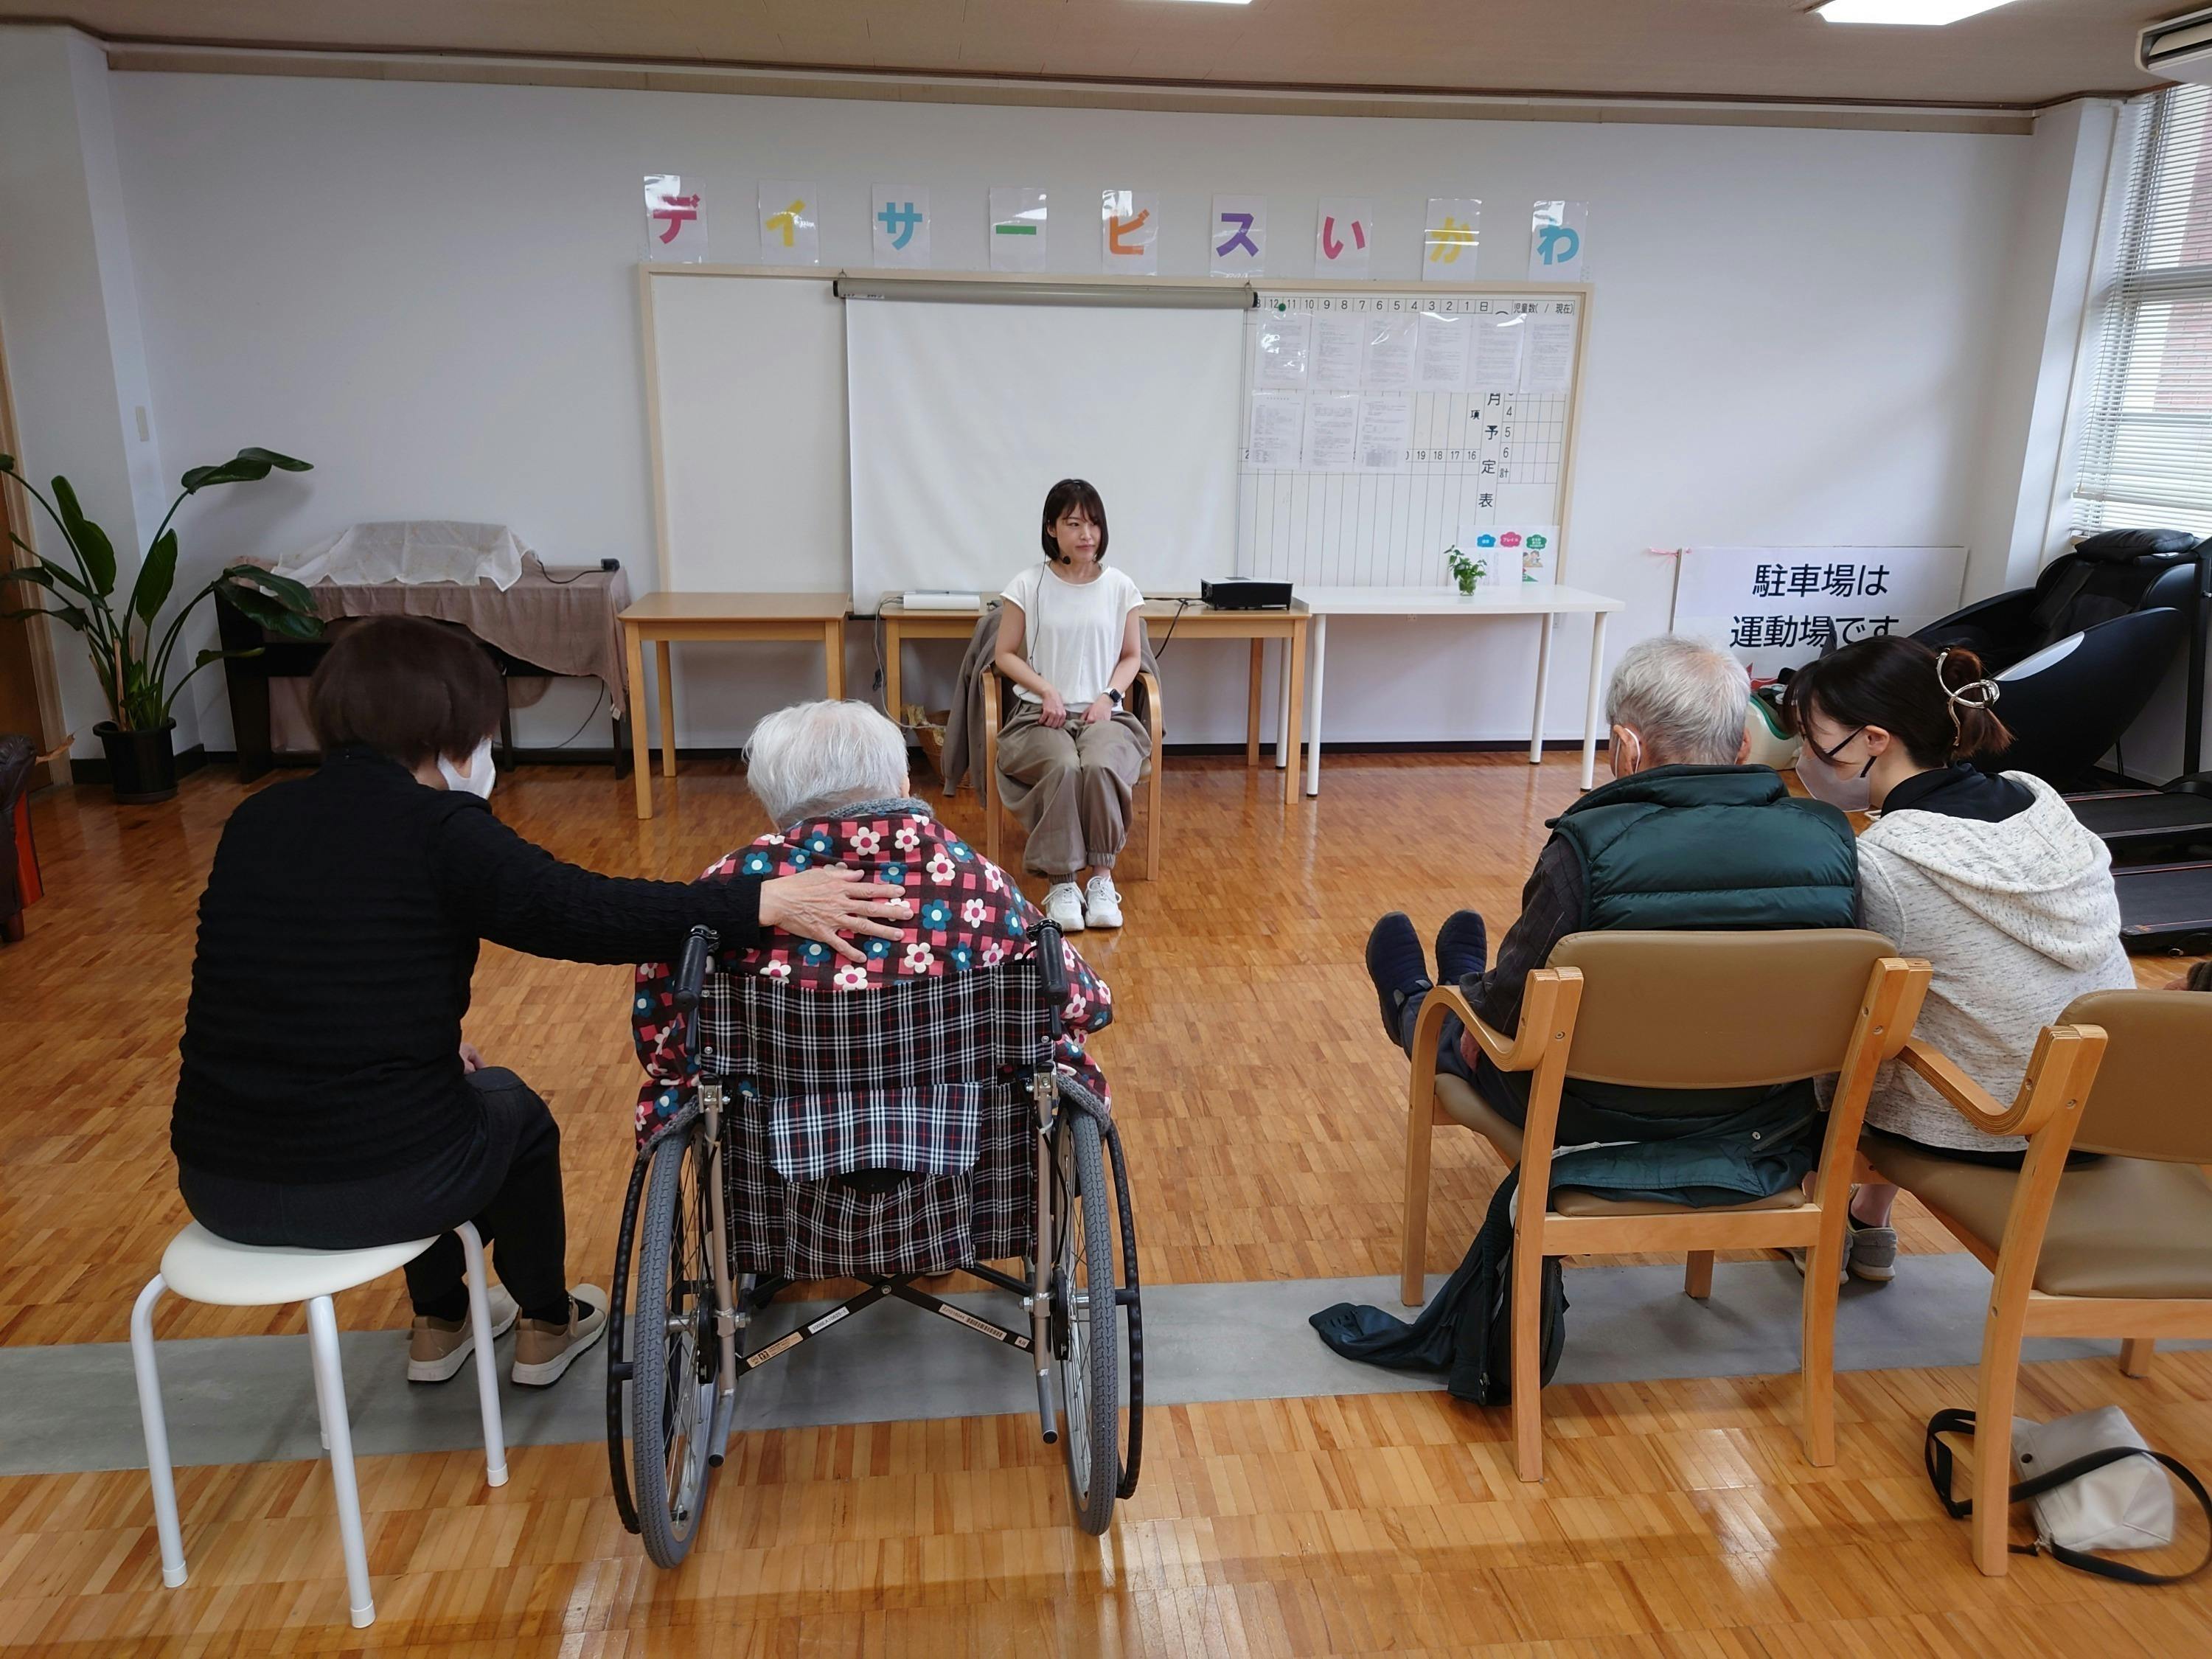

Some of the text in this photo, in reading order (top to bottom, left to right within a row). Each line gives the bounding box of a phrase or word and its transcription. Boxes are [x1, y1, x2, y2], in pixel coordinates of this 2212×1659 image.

[1270, 299, 1279, 309] 12
[1288, 299, 1296, 309] 11
[1305, 299, 1314, 309] 10
[1324, 299, 1330, 309] 9
[1341, 299, 1348, 310] 8
[1359, 300, 1365, 310] 7
[1376, 300, 1382, 310] 6
[1394, 300, 1400, 310] 5
[1411, 300, 1418, 310] 4
[1429, 301, 1435, 310] 3
[1446, 301, 1453, 311] 2
[1465, 302, 1470, 311] 1
[1480, 302, 1488, 311] 日
[1506, 406, 1512, 417] 4
[1504, 426, 1511, 437] 5
[1417, 451, 1426, 460] 19
[1434, 451, 1443, 460] 18
[1450, 451, 1460, 460] 17
[1468, 451, 1476, 460] 16
[1503, 447, 1509, 459] 6
[1499, 468, 1509, 478] 計
[1752, 563, 1890, 597] 駐車場は
